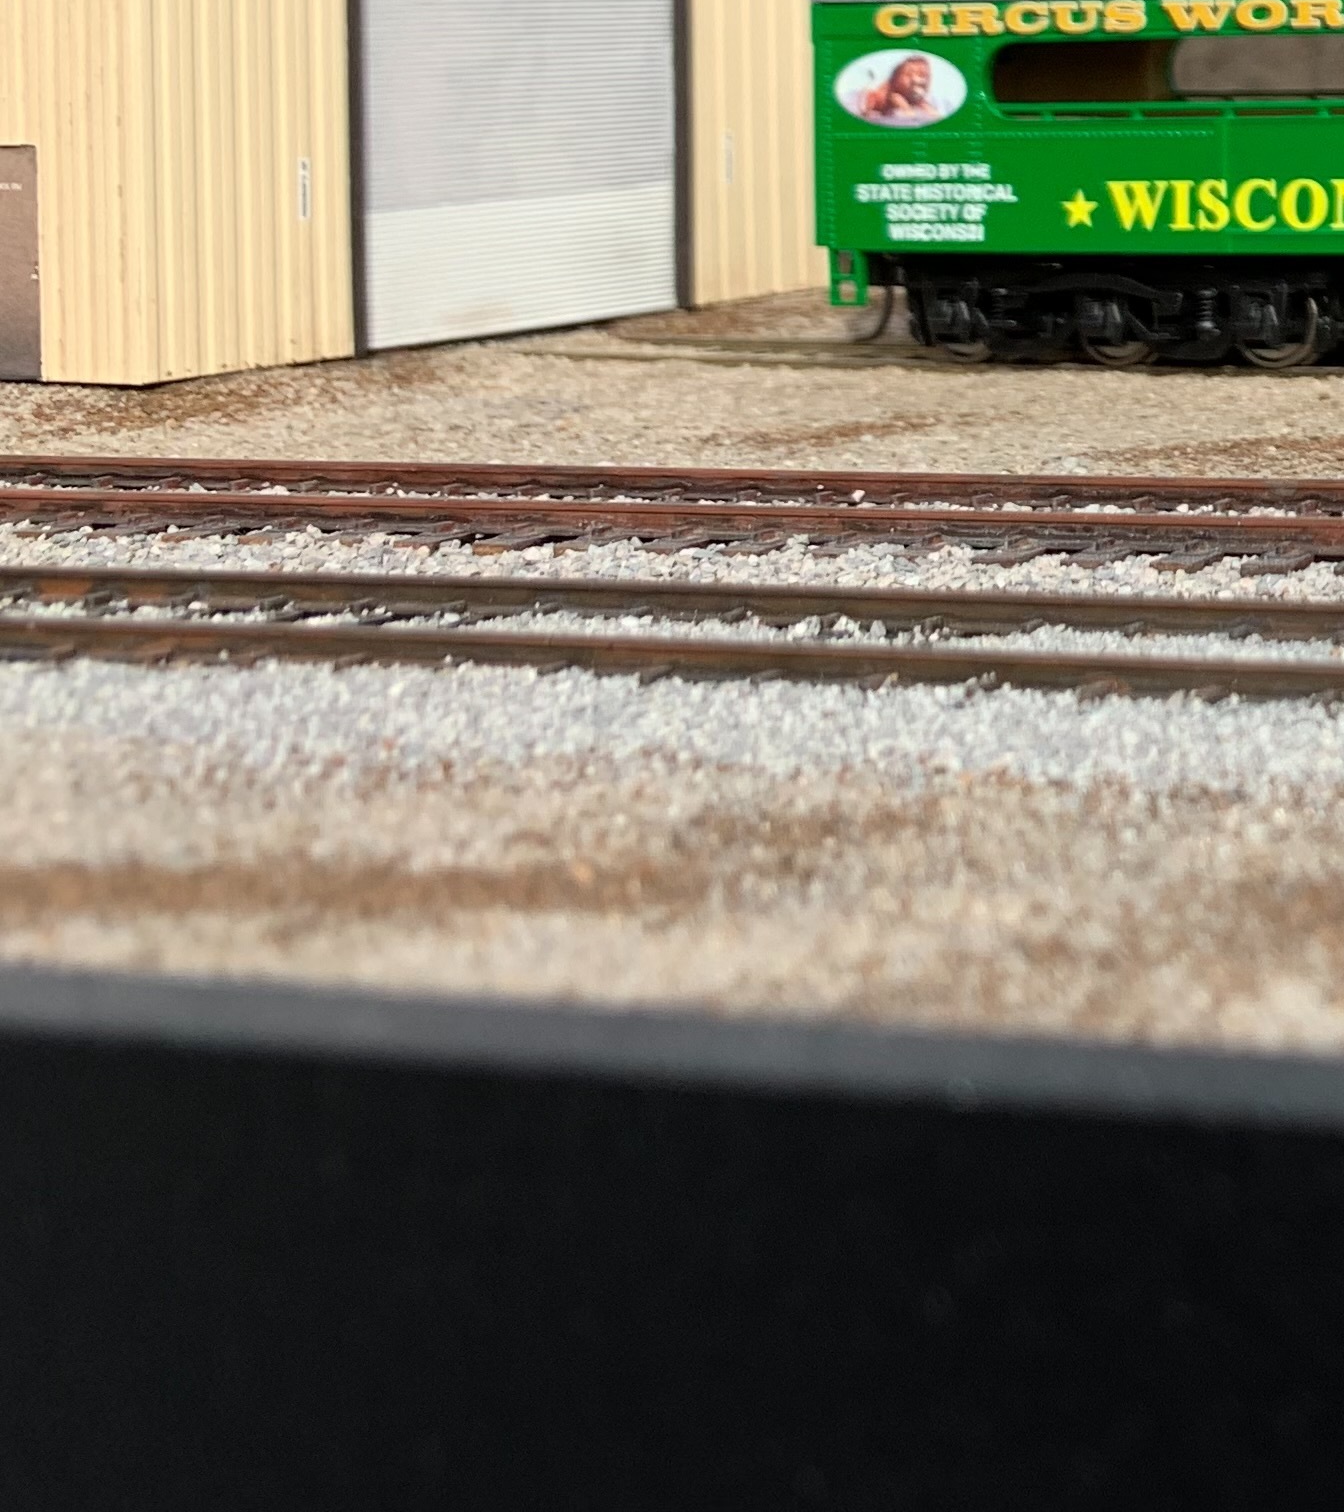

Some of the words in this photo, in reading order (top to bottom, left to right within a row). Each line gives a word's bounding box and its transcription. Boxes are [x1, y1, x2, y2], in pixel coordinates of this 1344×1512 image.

[874, 0, 1147, 37] CIRCUS
[938, 163, 959, 180] BY
[961, 163, 991, 180] THE
[856, 183, 912, 202] STATE
[914, 183, 1018, 202] HISTORICAL
[886, 203, 960, 221] SOCIETY
[962, 203, 988, 221] OF
